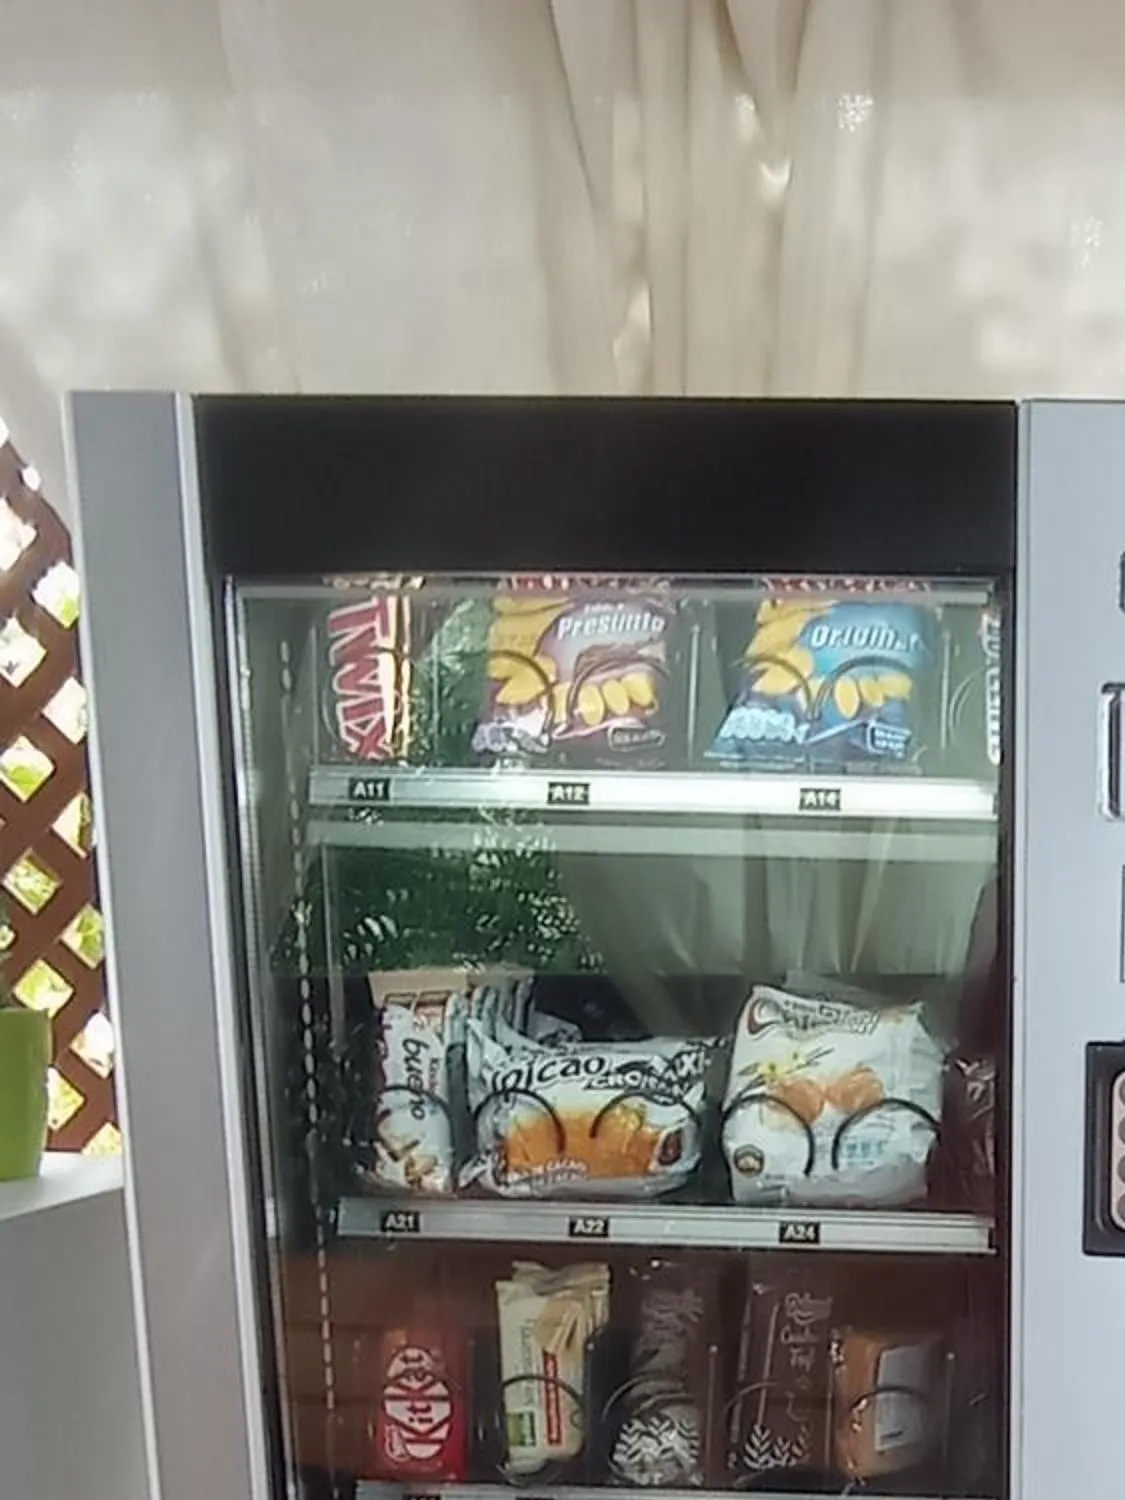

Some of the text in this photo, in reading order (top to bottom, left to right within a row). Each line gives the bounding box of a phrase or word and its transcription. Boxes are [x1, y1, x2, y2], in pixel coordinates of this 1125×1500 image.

[326, 595, 393, 760] TWIX
[353, 779, 385, 798] A11
[552, 785, 585, 802] A12
[803, 790, 838, 809] A14
[402, 1037, 430, 1121] bueno
[385, 1213, 415, 1229] A21
[573, 1219, 605, 1235] A22
[783, 1224, 817, 1241] A24
